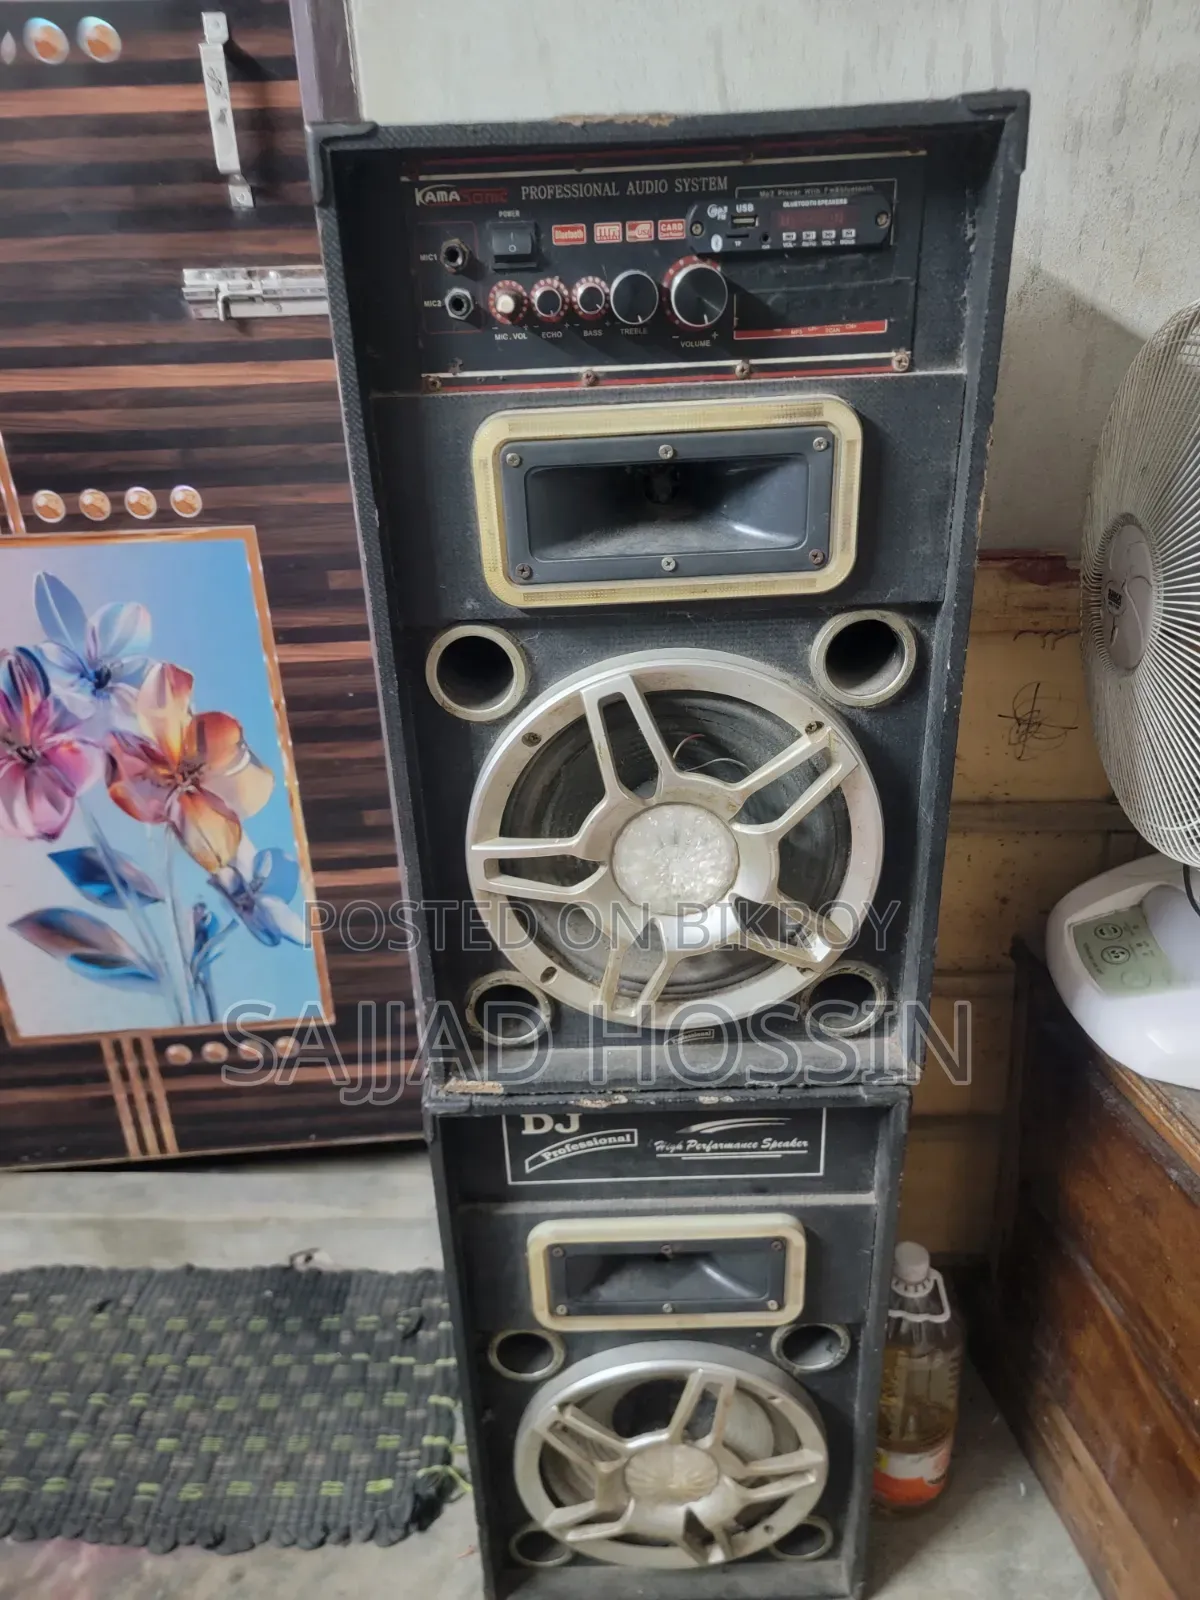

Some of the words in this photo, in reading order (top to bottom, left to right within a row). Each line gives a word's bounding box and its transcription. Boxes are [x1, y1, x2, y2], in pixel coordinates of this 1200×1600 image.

[521, 183, 620, 200] PROFESSIONAL
[626, 180, 669, 196] AUDIO
[674, 176, 729, 193] SYSTEM
[498, 209, 520, 218] POWER
[735, 203, 754, 214] USB
[660, 222, 684, 232] CARD
[423, 300, 442, 308] MIC2
[541, 330, 563, 339] ECHO
[620, 327, 648, 336] TREBLE
[680, 340, 711, 348] VOLUME
[520, 1113, 583, 1135] DJ
[540, 1134, 632, 1162] Professional
[654, 1139, 684, 1153] High
[760, 1137, 809, 1149] Speaker
